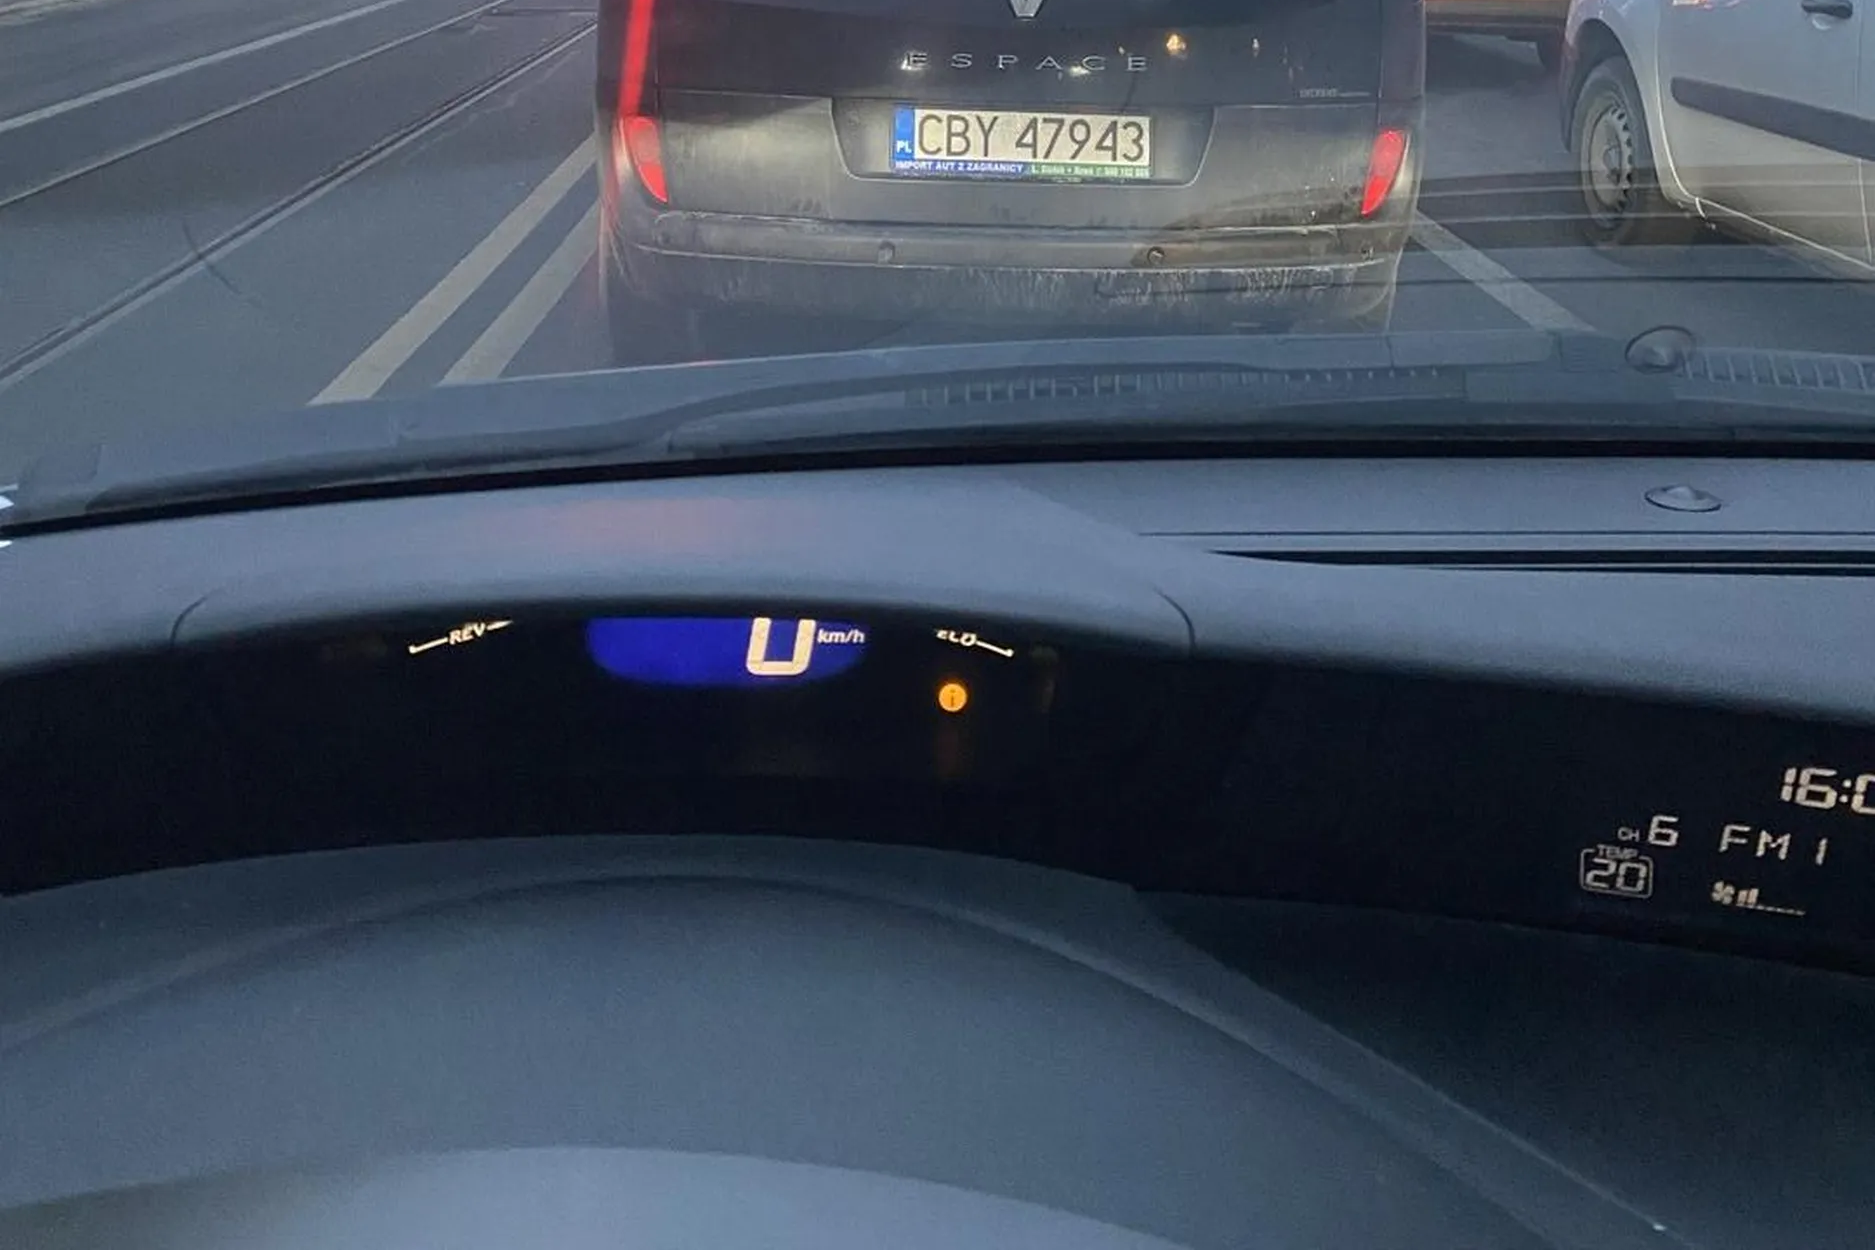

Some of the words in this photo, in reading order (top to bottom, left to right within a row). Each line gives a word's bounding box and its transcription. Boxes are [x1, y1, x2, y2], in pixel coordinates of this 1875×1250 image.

[900, 52, 1148, 72] ESPACE
[896, 140, 912, 153] PL
[918, 113, 998, 157] CBY
[1015, 116, 1144, 162] 47943
[895, 160, 932, 169] IMPORT
[935, 161, 956, 170] AUT
[967, 163, 1024, 172] ZAGRANICY
[449, 622, 486, 645] REV
[817, 629, 865, 644] km/h
[1617, 826, 1640, 842] CH
[1648, 814, 1679, 847] 6
[1597, 844, 1639, 860] TEMP
[1584, 858, 1648, 892] 20
